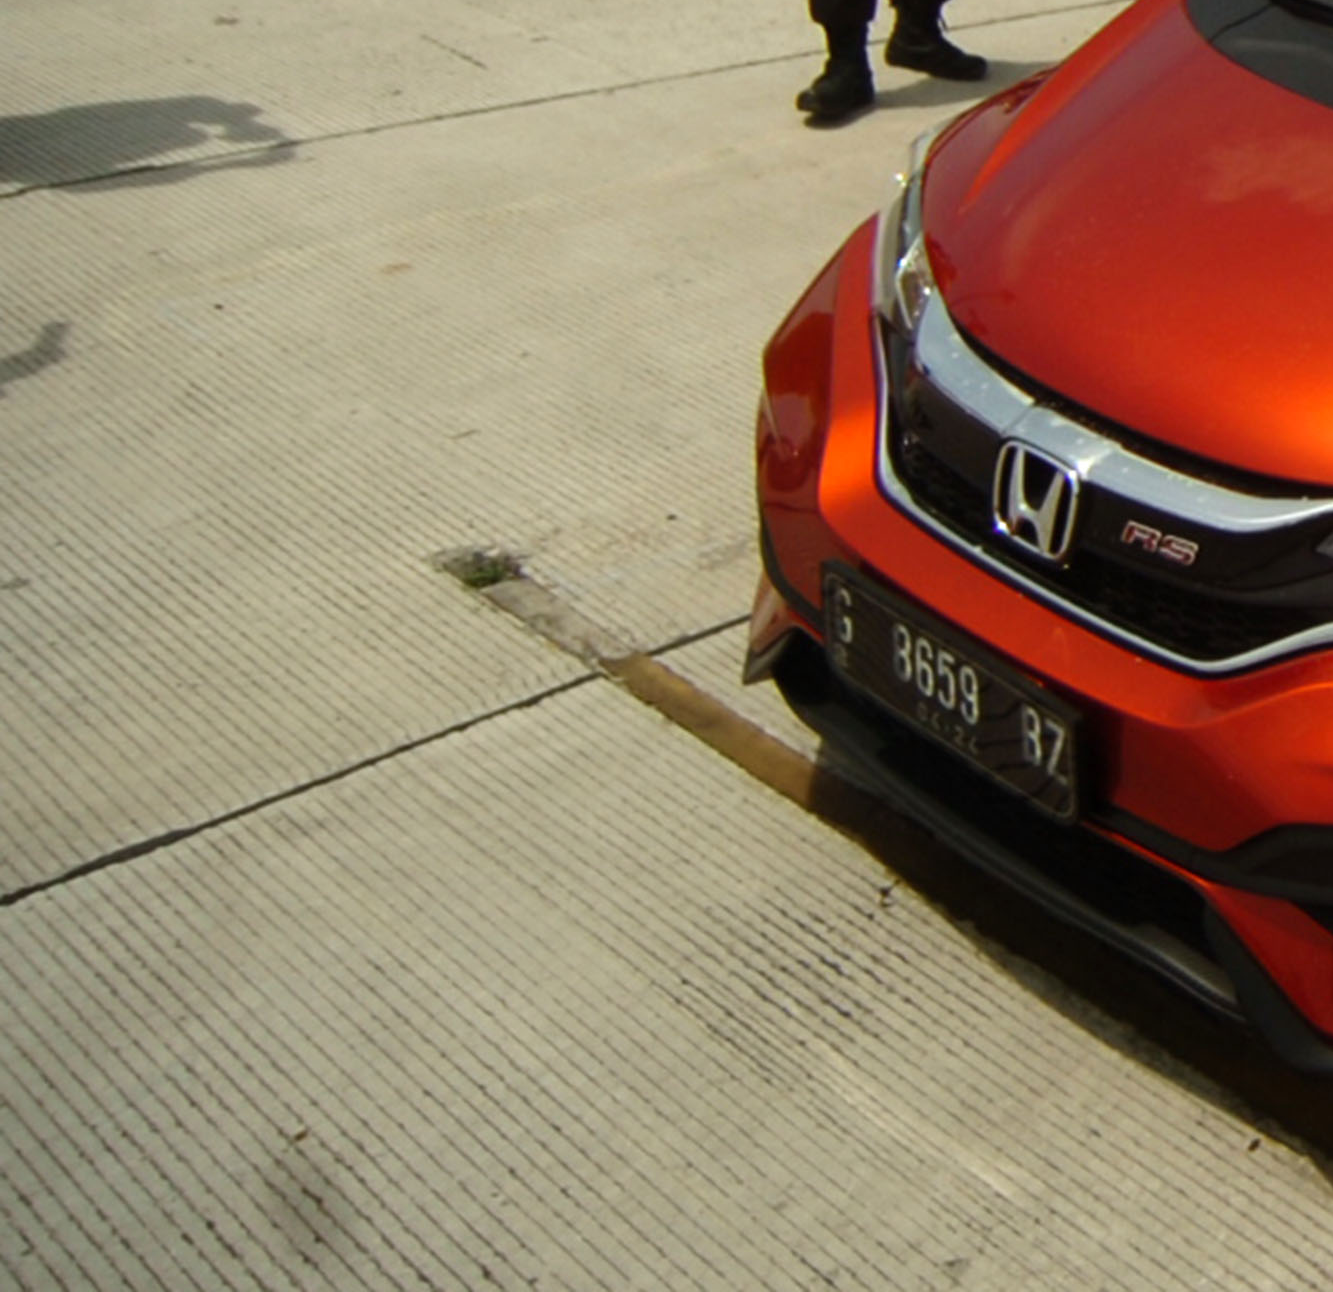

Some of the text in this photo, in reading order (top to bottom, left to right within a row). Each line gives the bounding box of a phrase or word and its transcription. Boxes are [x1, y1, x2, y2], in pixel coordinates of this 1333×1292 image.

[1122, 520, 1199, 565] RS
[834, 588, 855, 645] G
[892, 623, 981, 726] 8659
